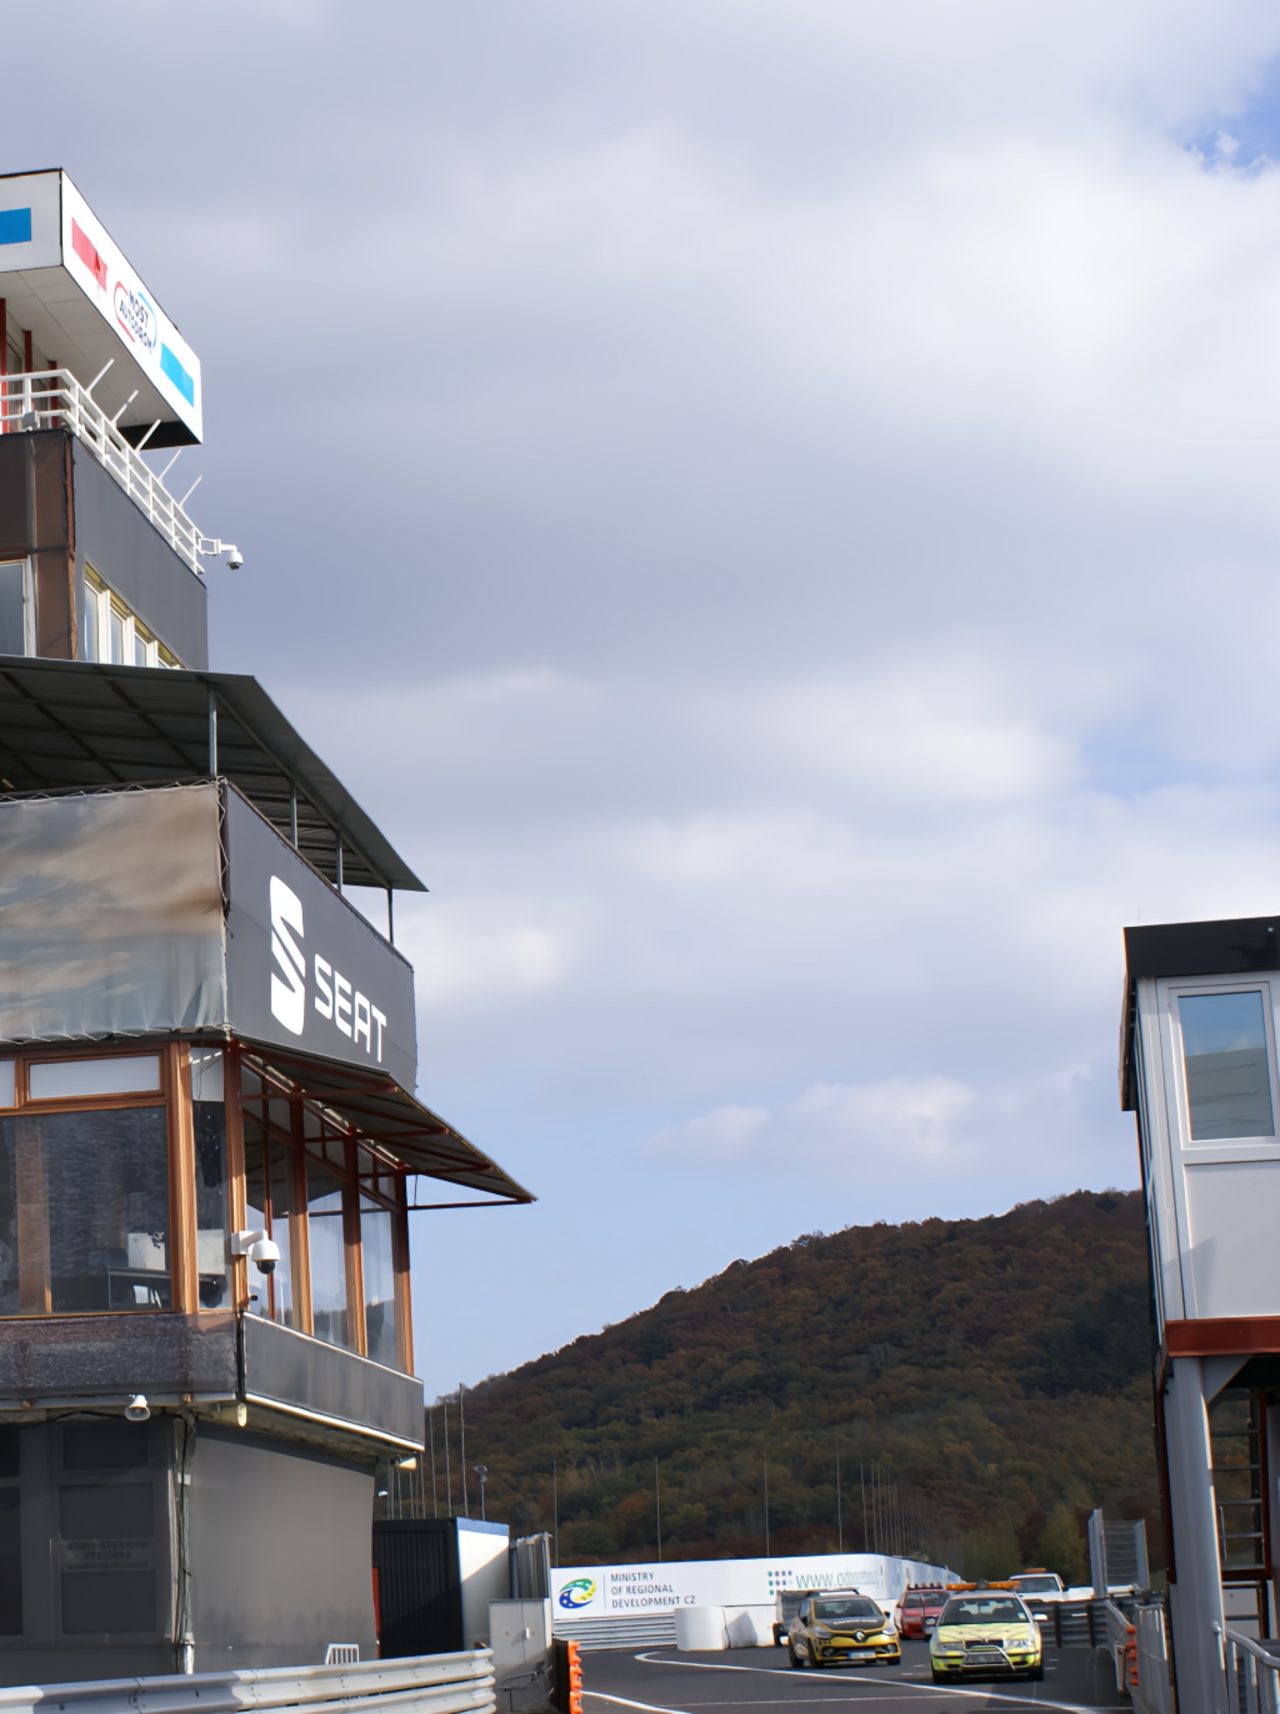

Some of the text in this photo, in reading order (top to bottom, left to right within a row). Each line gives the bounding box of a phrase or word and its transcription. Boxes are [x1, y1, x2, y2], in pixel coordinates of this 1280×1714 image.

[129, 290, 148, 328] MOST
[315, 954, 387, 1063] SEAT
[610, 1572, 655, 1582] MINISTRY
[611, 1584, 674, 1595] OF REGIONAL
[612, 1595, 696, 1608] DEVELOPMENT CZ
